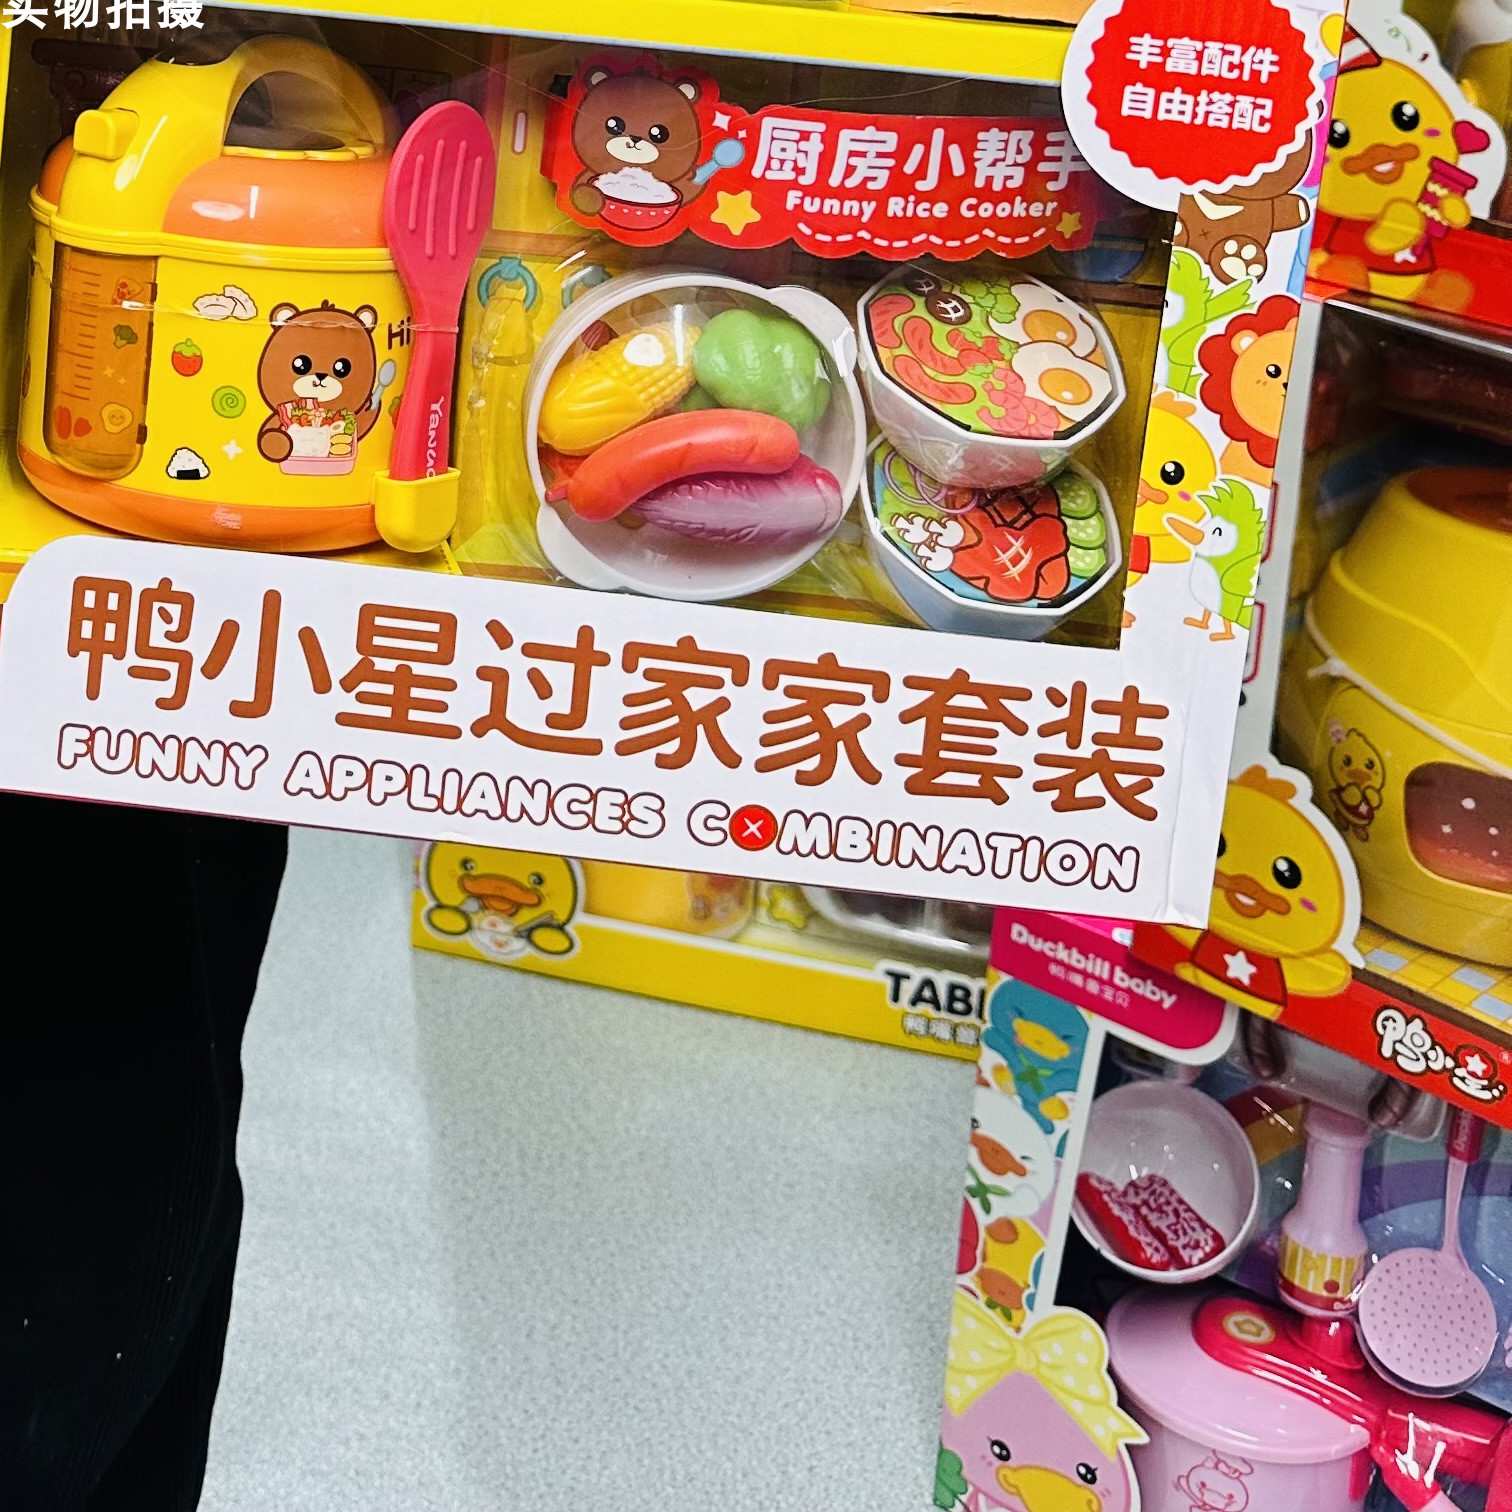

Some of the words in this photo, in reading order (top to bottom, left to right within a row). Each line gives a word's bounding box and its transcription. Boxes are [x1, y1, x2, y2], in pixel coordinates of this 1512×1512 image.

[1124, 33, 1281, 85] 丰富配件
[1120, 83, 1275, 135] 自由搭配
[751, 116, 1091, 192] 厨房小帮手
[786, 190, 877, 223] Funny
[887, 195, 950, 220] Rice
[959, 196, 1058, 221] Cooker
[66, 576, 1171, 822] 鸭小星过家家套装
[57, 723, 269, 790] FUNNY
[284, 750, 666, 840] APPLIANCES
[687, 798, 1140, 893] COMBINATION
[1010, 922, 1110, 981] Duckbill
[1112, 965, 1178, 1010] baby
